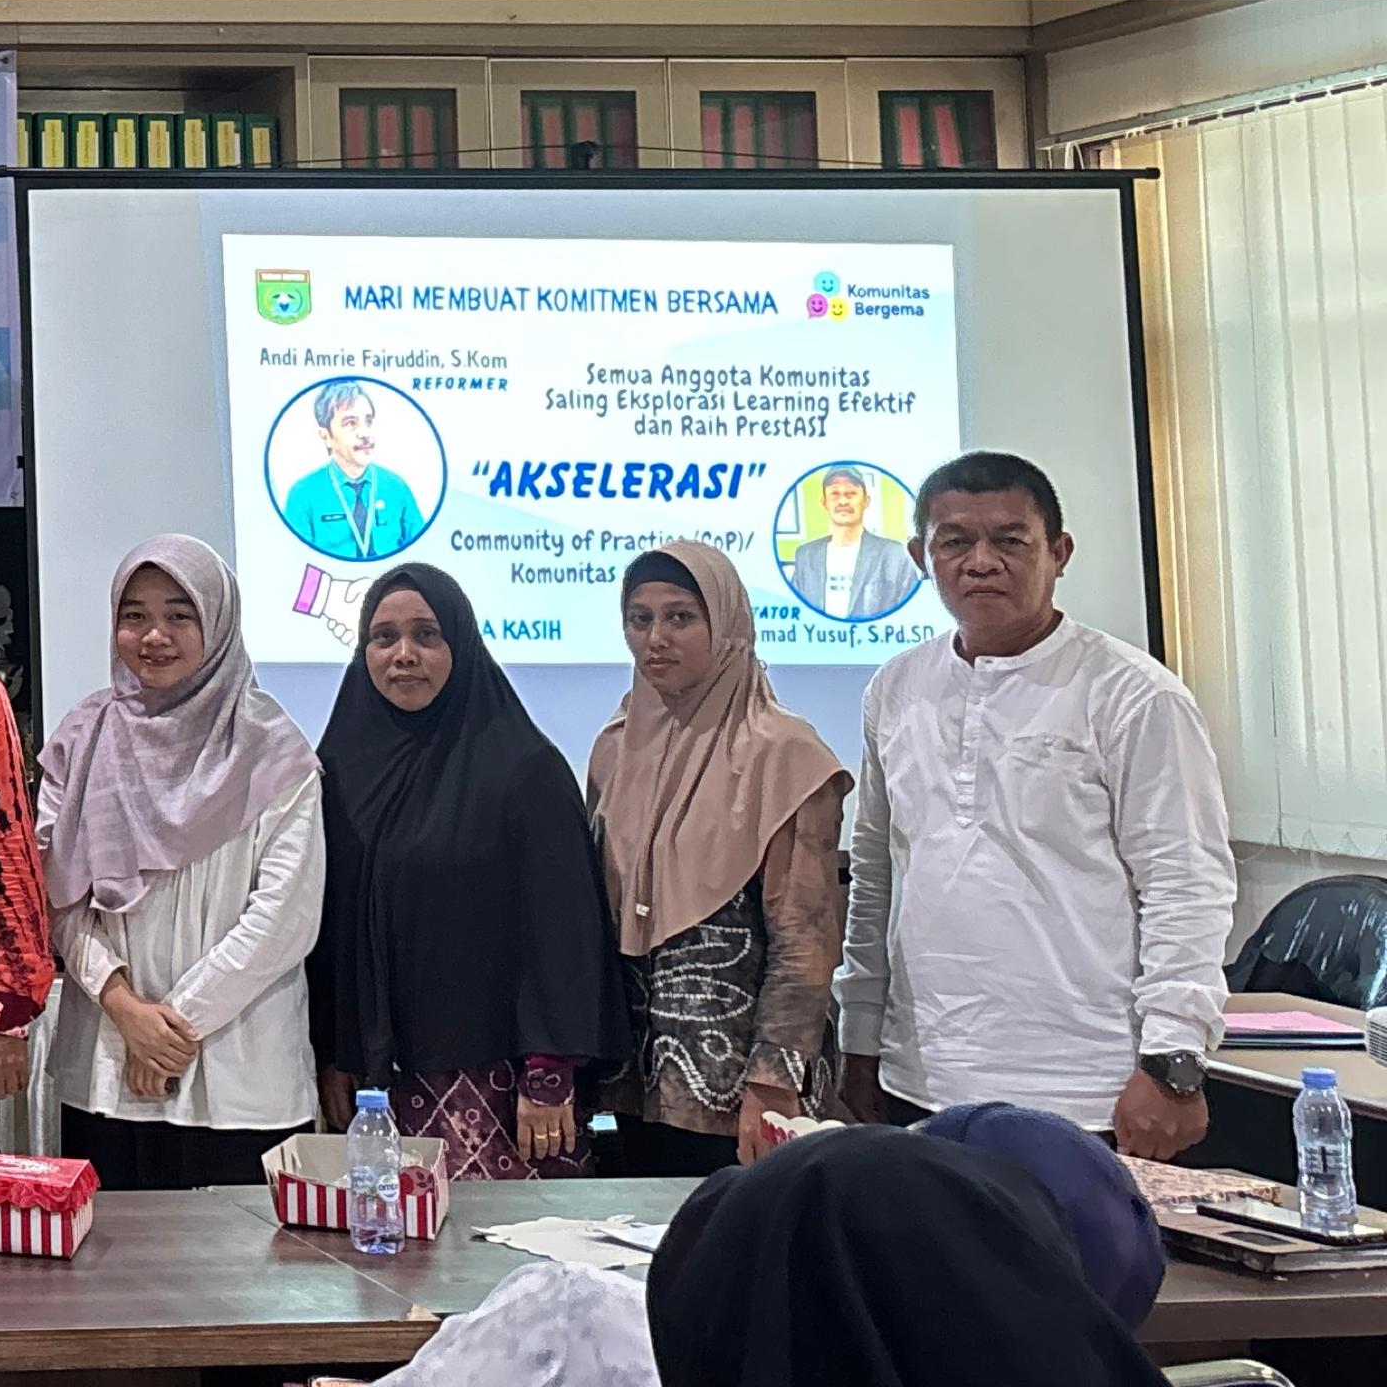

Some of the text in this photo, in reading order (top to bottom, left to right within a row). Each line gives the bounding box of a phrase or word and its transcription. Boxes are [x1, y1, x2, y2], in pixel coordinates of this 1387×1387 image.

[344, 285, 779, 316] MARI MEMBUAT KOMITMEN BERSAMA
